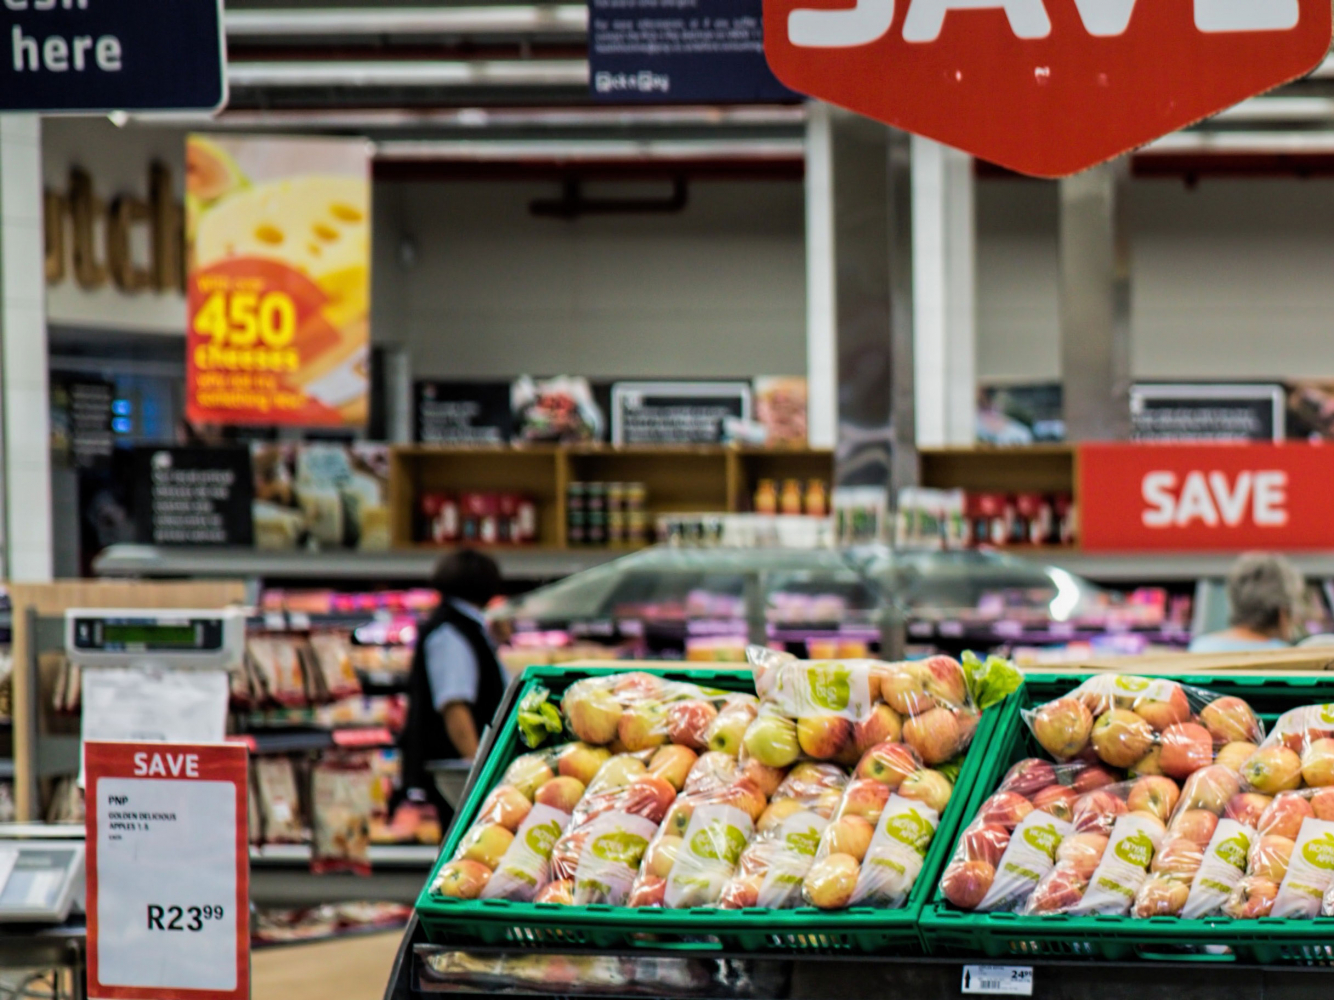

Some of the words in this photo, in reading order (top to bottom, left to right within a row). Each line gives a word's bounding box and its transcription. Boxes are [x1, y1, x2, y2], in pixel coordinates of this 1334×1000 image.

[12, 24, 122, 72] here
[194, 290, 296, 347] 450
[1141, 470, 1288, 527] SAVE
[134, 752, 200, 778] SAVE
[108, 795, 128, 806] PNP
[108, 812, 138, 820] GOLDEN
[139, 812, 176, 821] DELICIOUS
[110, 823, 136, 831] APPLES
